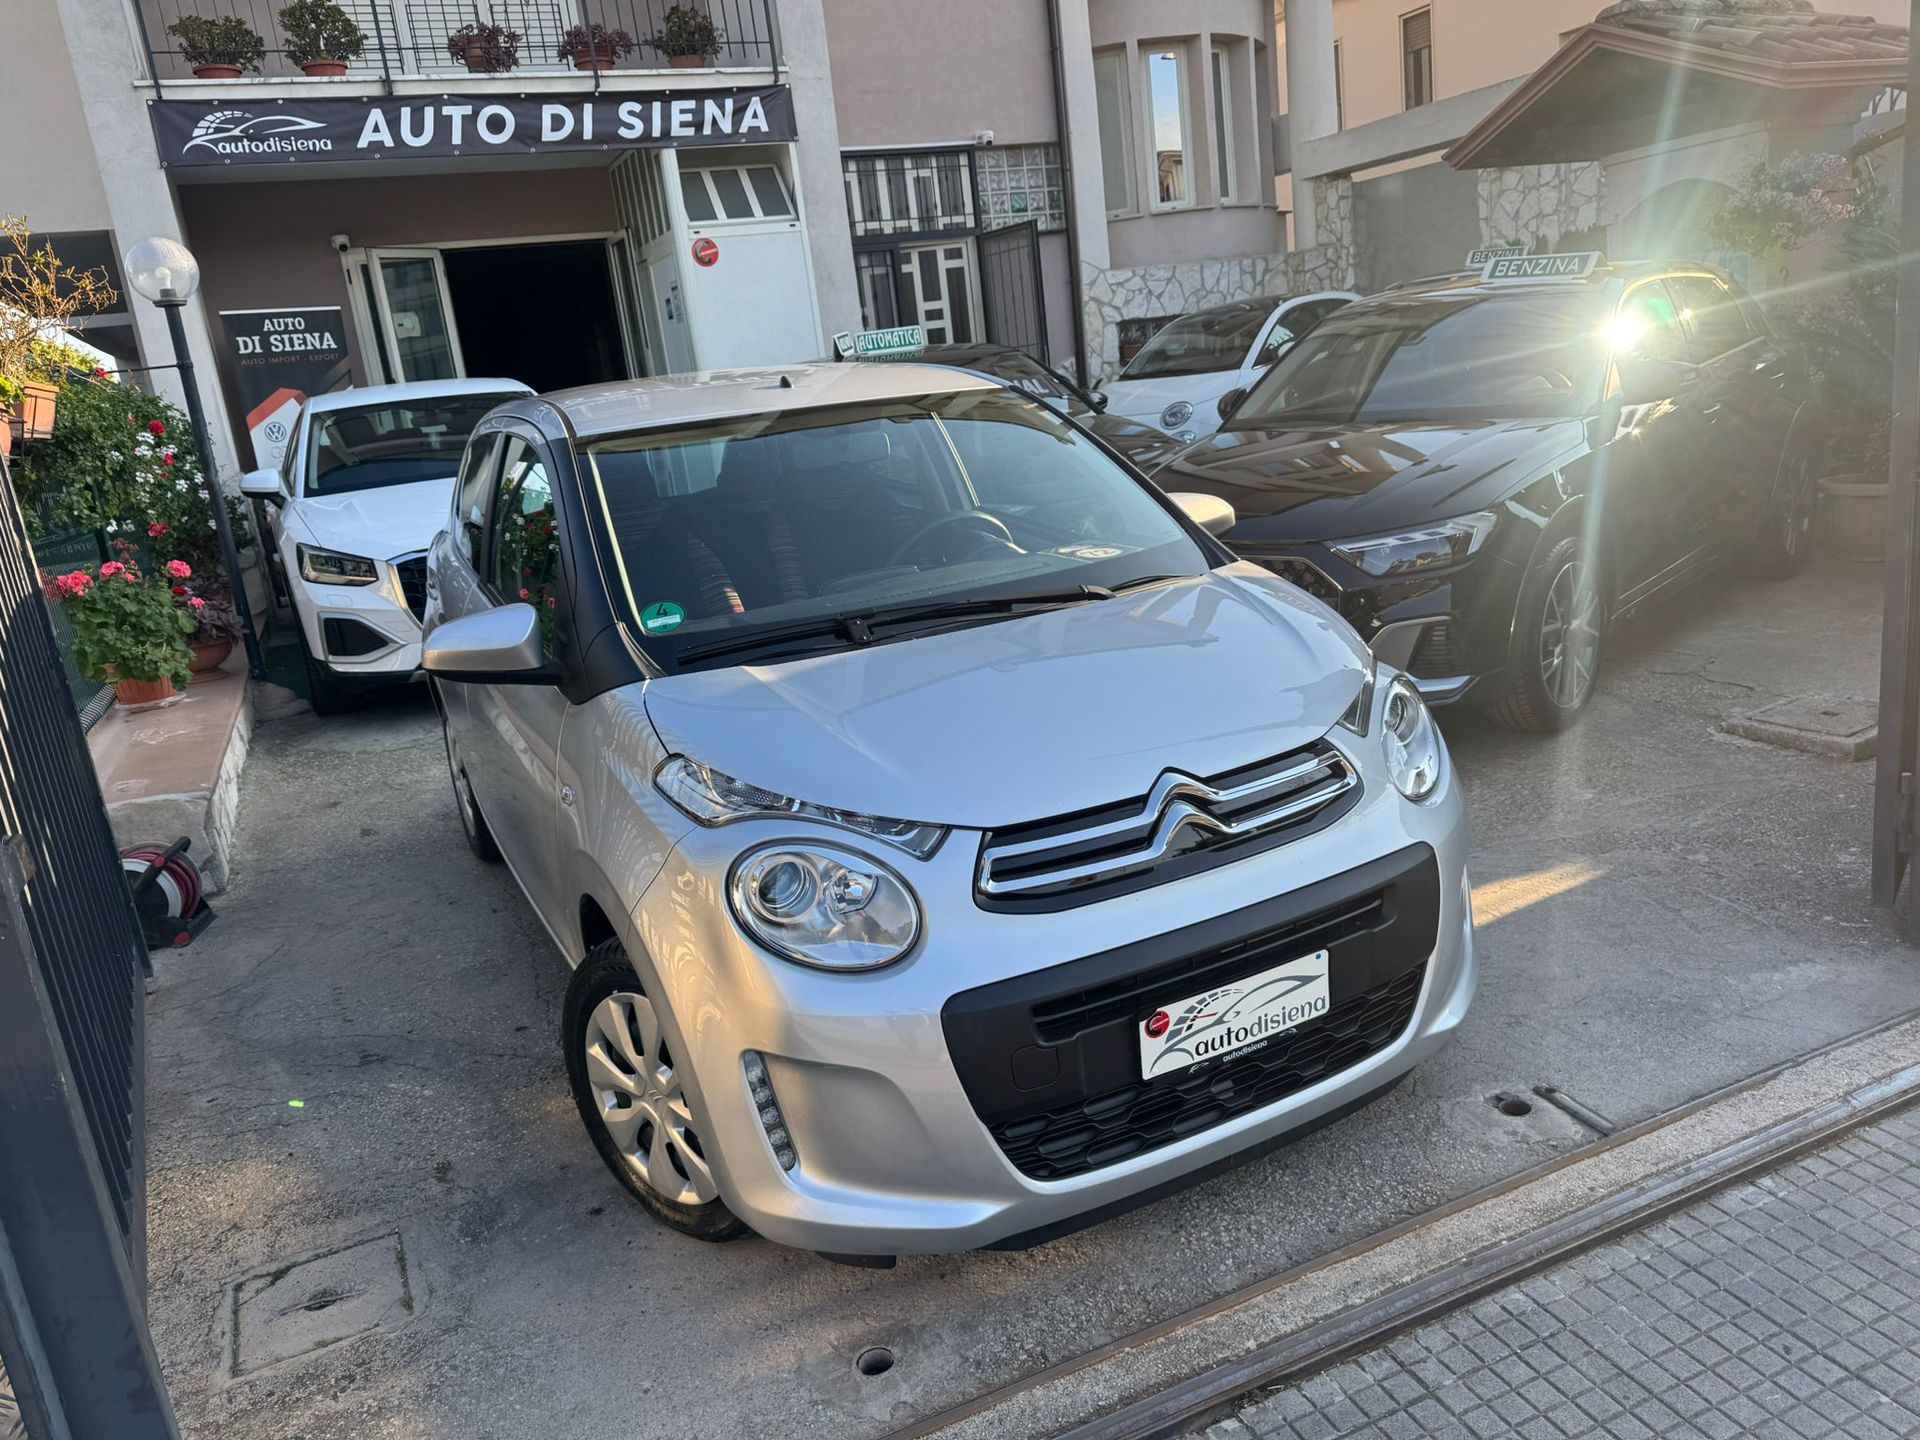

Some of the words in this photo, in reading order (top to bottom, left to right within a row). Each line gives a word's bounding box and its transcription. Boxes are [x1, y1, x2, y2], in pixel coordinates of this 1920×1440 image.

[357, 105, 515, 148] AUTO
[540, 102, 593, 142] DI
[616, 96, 770, 140] SIENA
[218, 137, 332, 154] autodisiena
[1494, 257, 1579, 276] BENZINA
[263, 317, 305, 331] AUTO
[235, 335, 263, 354] DI
[269, 332, 338, 352] SIENA
[858, 329, 921, 351] AUTOMATICA
[656, 603, 669, 617] 4
[1195, 995, 1326, 1057] autodisiena
[1222, 1040, 1268, 1062] autodisiena
